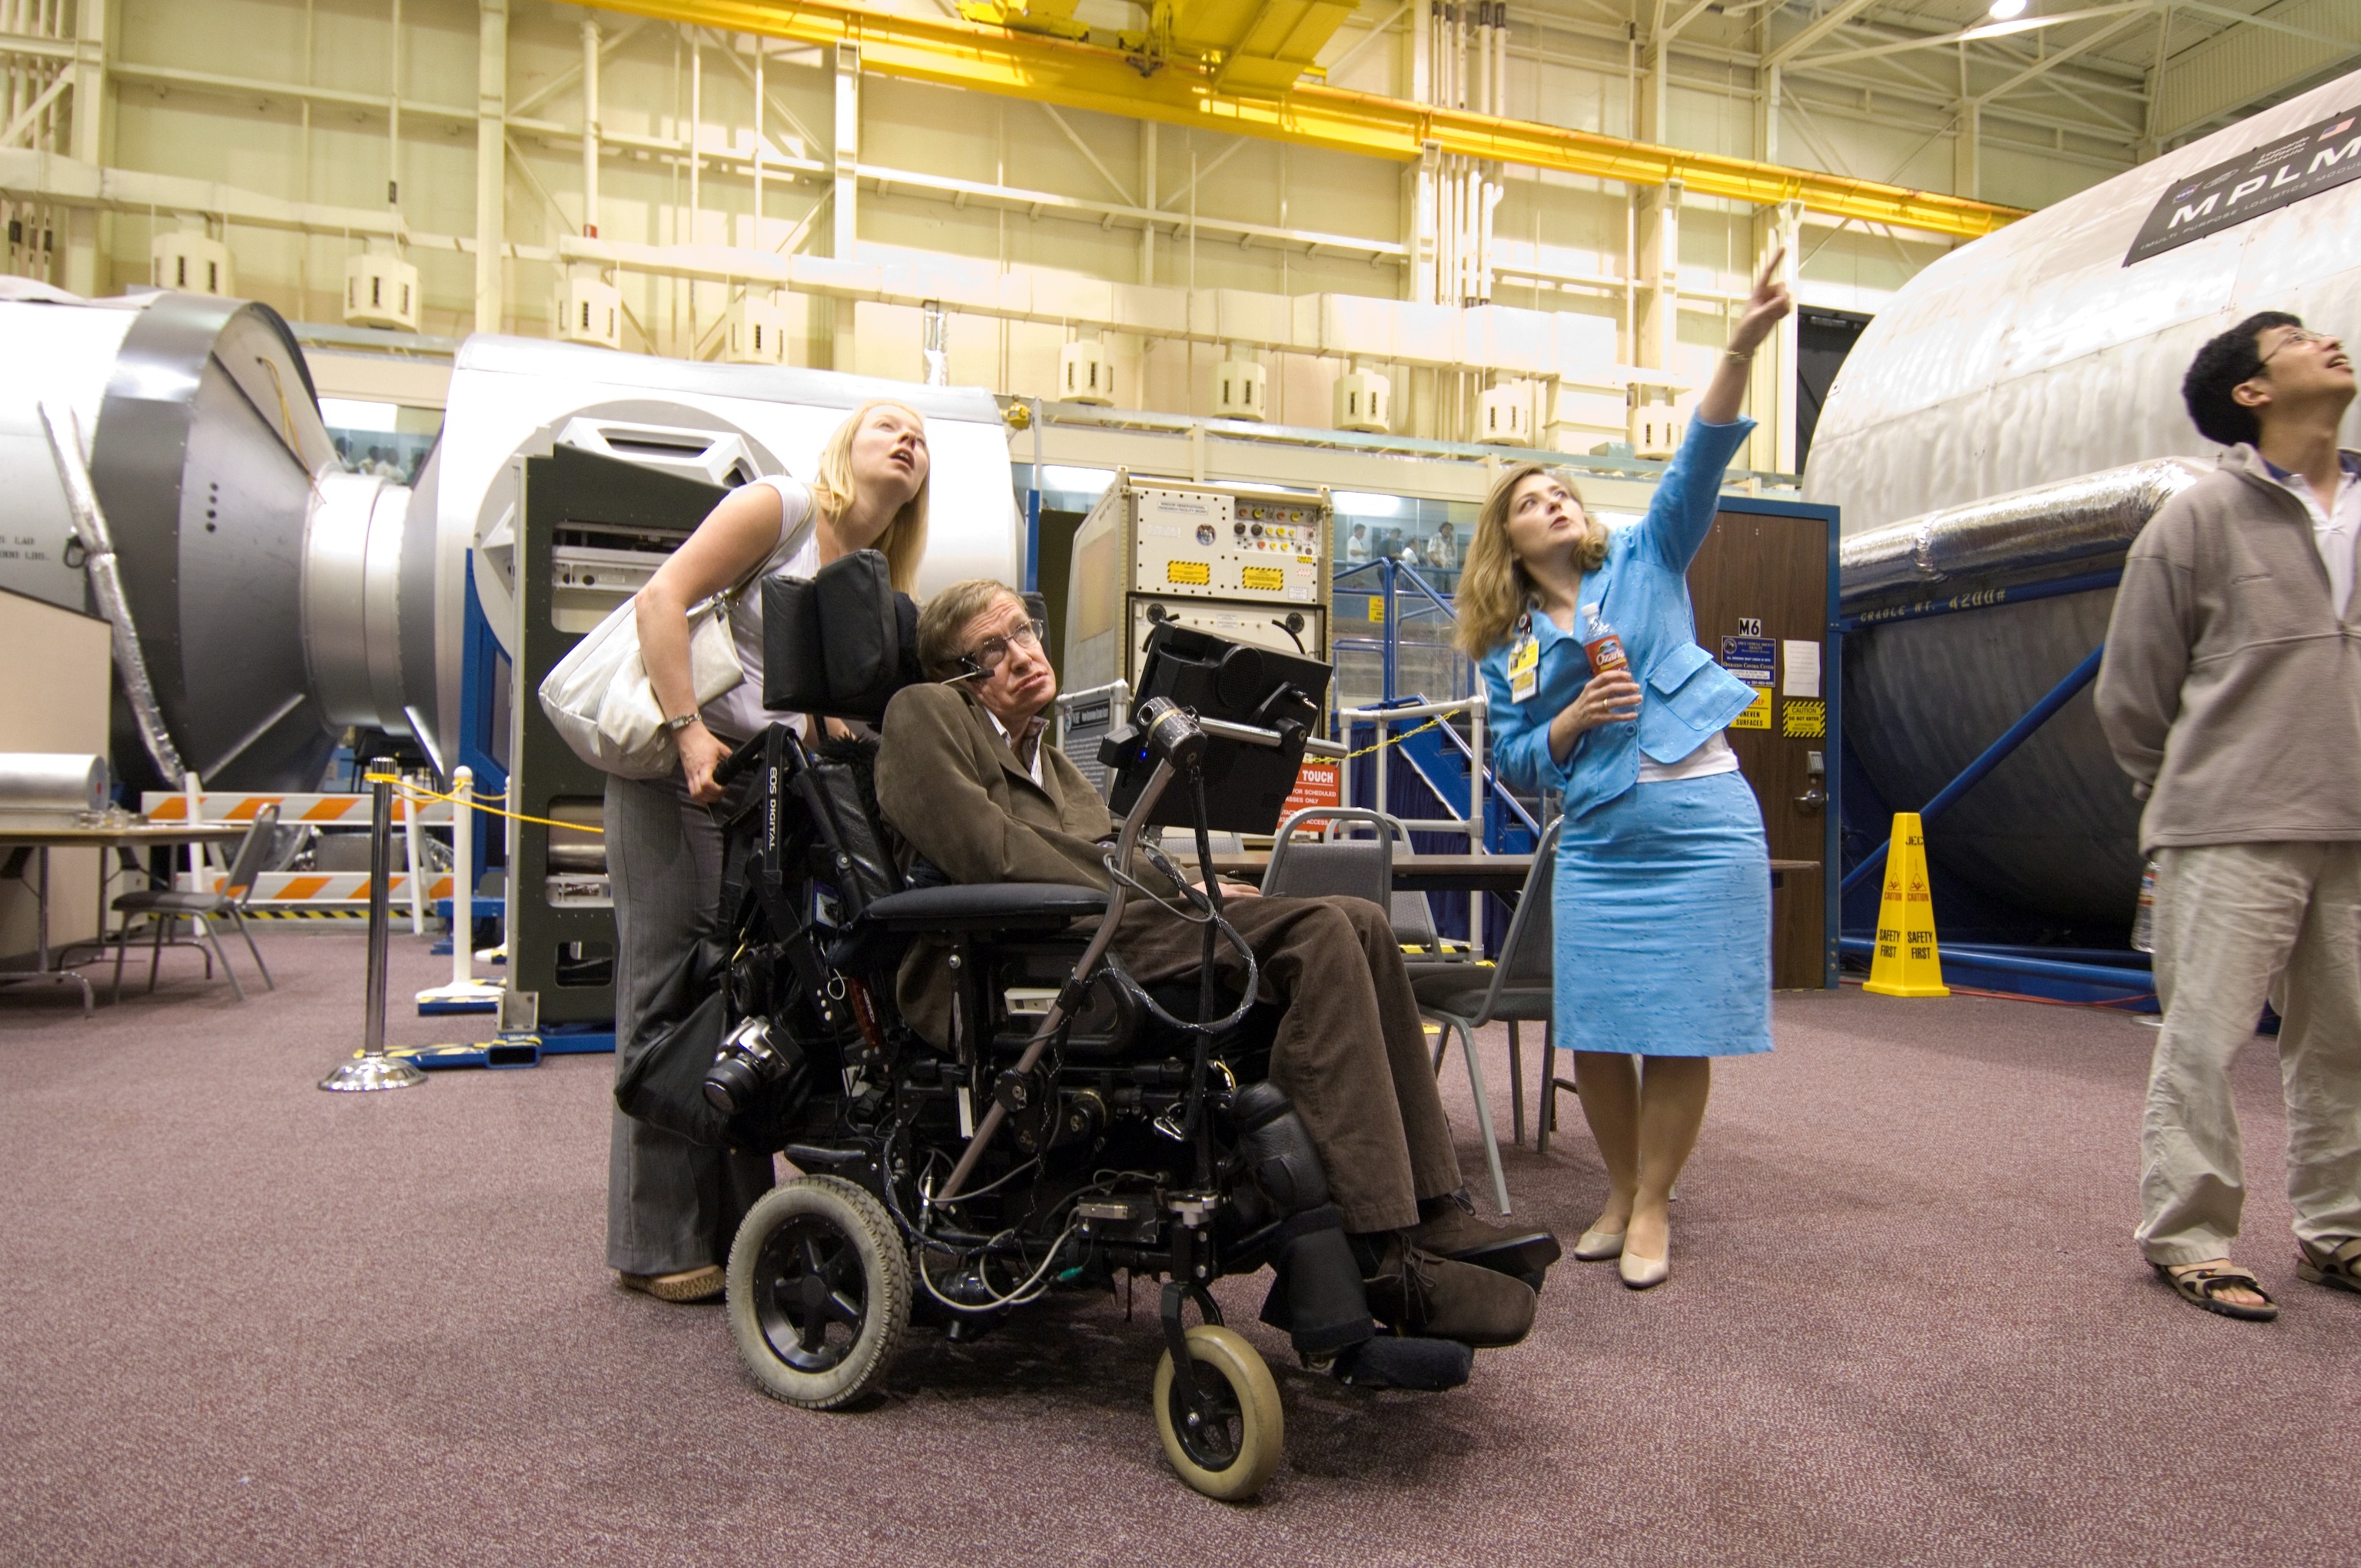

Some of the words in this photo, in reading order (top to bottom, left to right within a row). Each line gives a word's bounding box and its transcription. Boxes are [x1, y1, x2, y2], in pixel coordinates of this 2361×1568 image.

[2167, 135, 2361, 230] MPLM
[2183, 209, 2238, 234] PURPOSE
[2244, 181, 2308, 211] LOGISTICS
[1860, 605, 1906, 622] CRADLE
[1739, 620, 1760, 636] M6
[769, 766, 778, 795] EOS
[1302, 769, 1333, 783] TOUCH
[1304, 789, 1337, 797] SCHEDULED
[769, 799, 777, 852] DIGITAL
[1884, 891, 1902, 902] CAUTION
[1907, 892, 1929, 902] CAUTION
[1879, 929, 1901, 942] SAFETY
[1907, 931, 1933, 944] SAFETY
[1880, 946, 1897, 958] FIRST
[1911, 947, 1931, 959] FIRST
